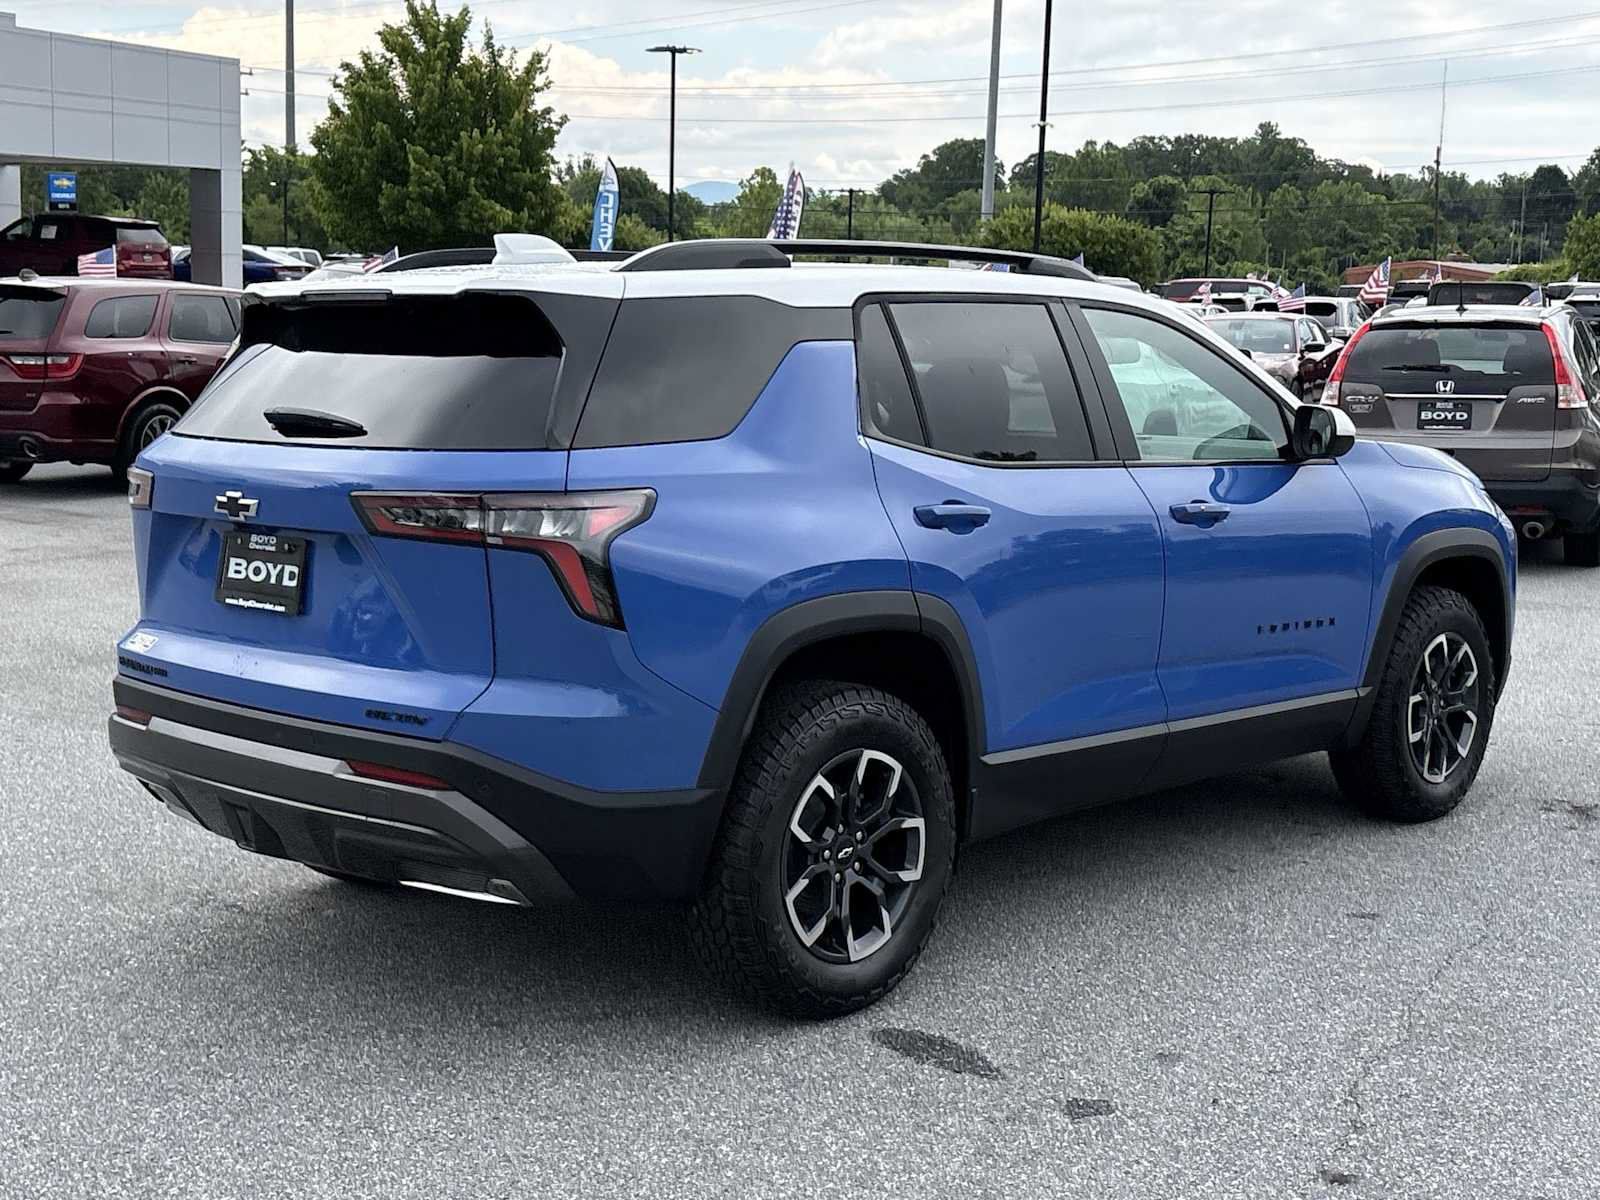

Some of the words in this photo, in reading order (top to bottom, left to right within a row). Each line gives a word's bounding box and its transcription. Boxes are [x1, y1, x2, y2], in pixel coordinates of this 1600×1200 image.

[1420, 411, 1468, 420] BOYD
[250, 534, 277, 545] BOYD
[227, 557, 299, 587] BOYD
